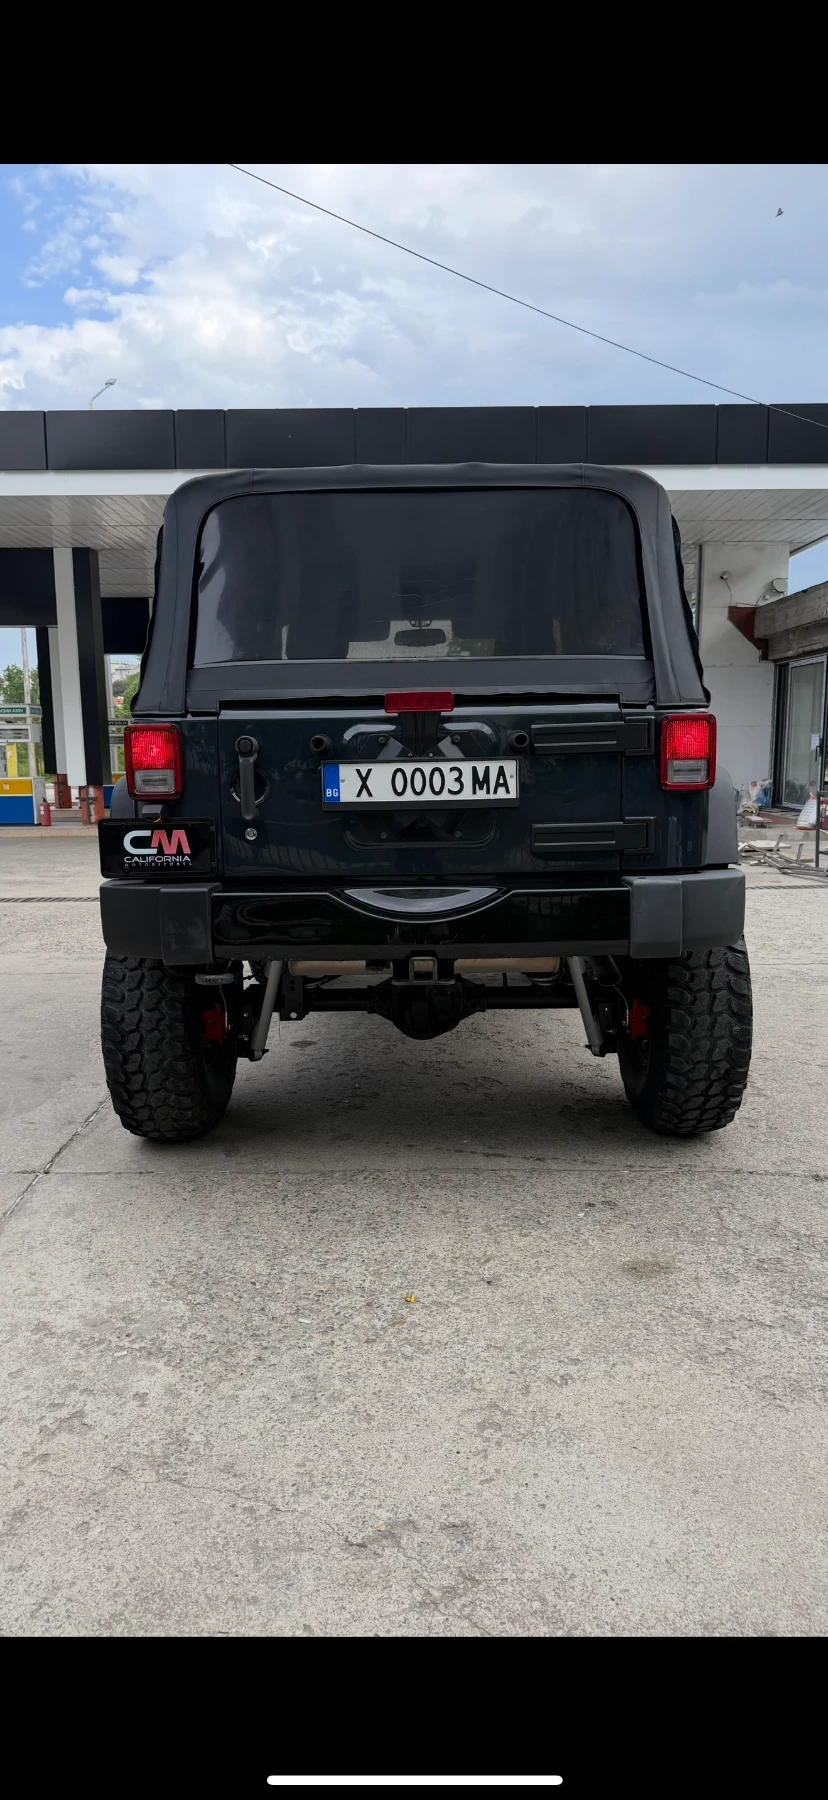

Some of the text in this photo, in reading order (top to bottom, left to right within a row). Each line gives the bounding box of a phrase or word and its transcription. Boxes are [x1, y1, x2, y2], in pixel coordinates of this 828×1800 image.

[355, 765, 511, 798] X 0003 MA
[326, 788, 339, 798] BG
[123, 829, 191, 855] CM
[124, 855, 191, 863] CALIFORNIA
